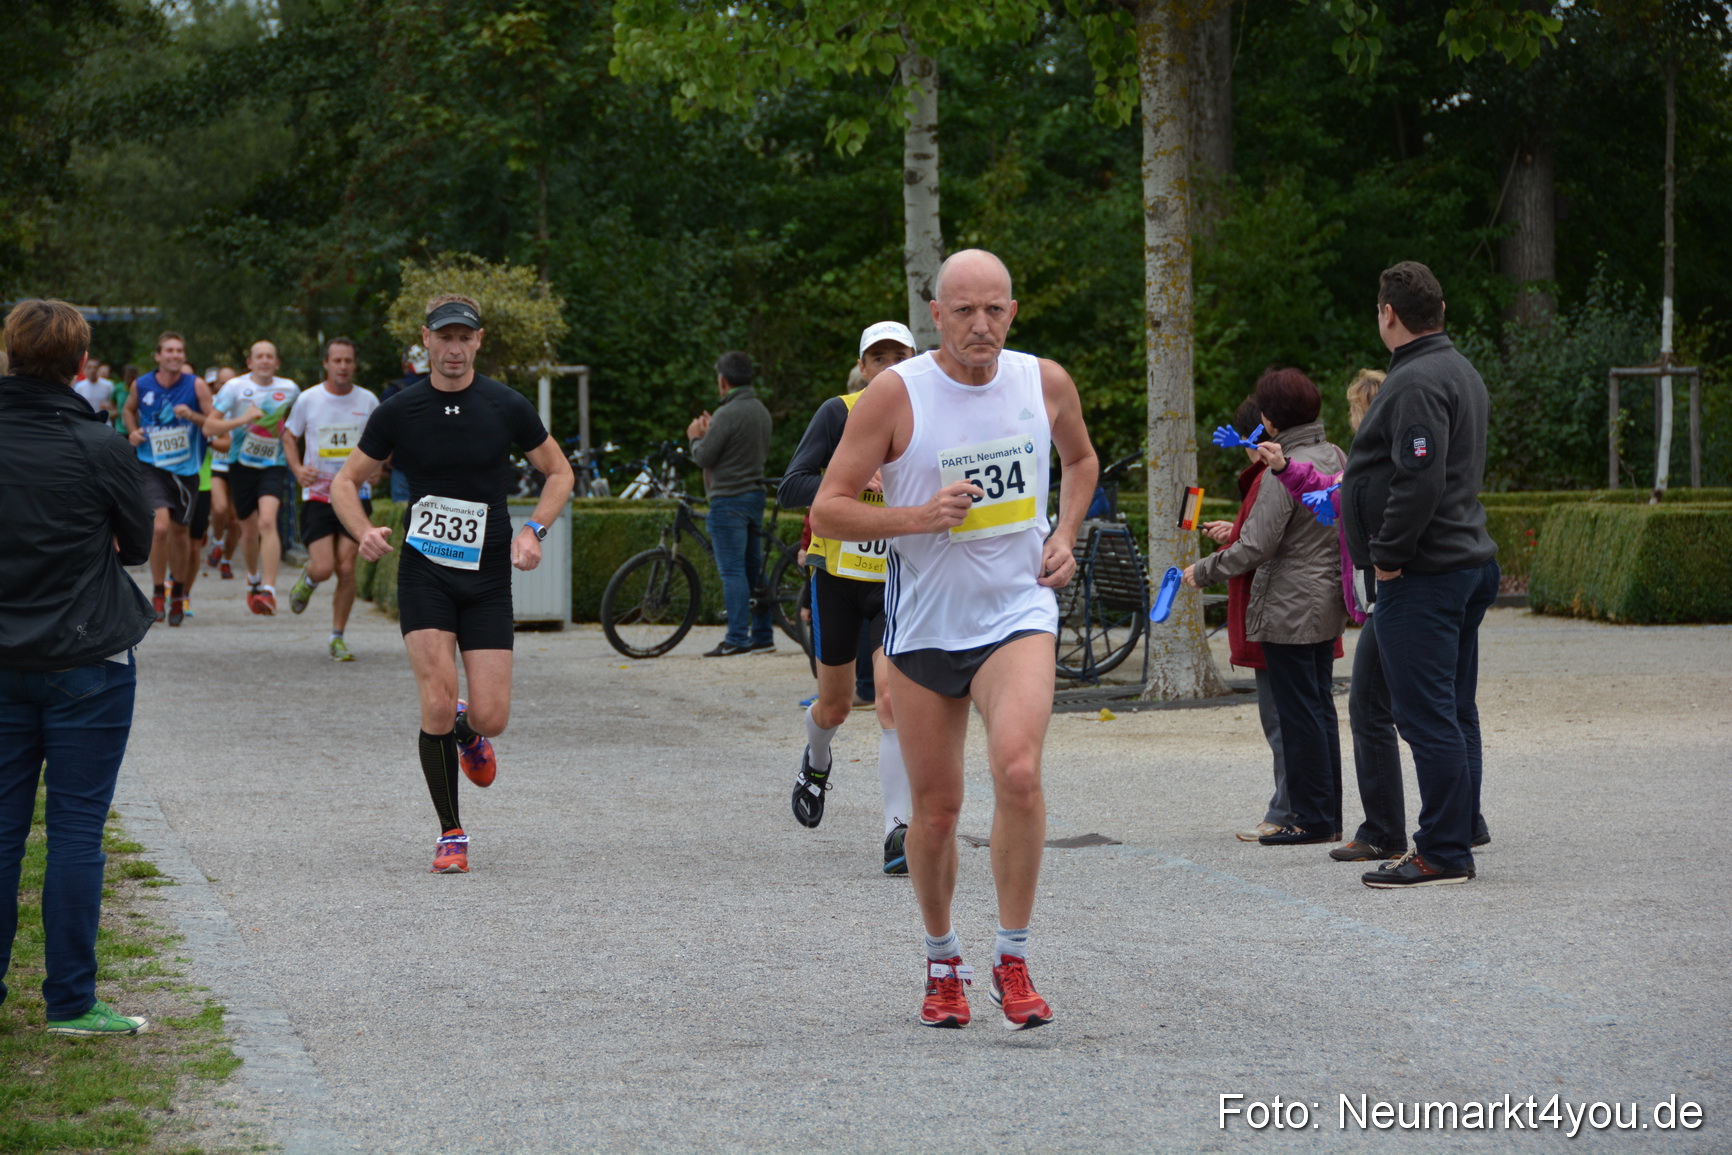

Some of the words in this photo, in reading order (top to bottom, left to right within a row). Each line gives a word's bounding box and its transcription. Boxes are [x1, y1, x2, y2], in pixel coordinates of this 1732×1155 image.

[155, 436, 187, 453] 2092
[330, 433, 348, 446] 44
[941, 454, 976, 469] PARTL
[976, 446, 1022, 462] Neumarkt
[964, 460, 1026, 503] 534
[417, 500, 439, 510] ARTL
[440, 504, 475, 516] Neumarkt
[417, 510, 478, 544] 2533
[421, 542, 465, 559] Christian
[854, 555, 885, 572] Josef
